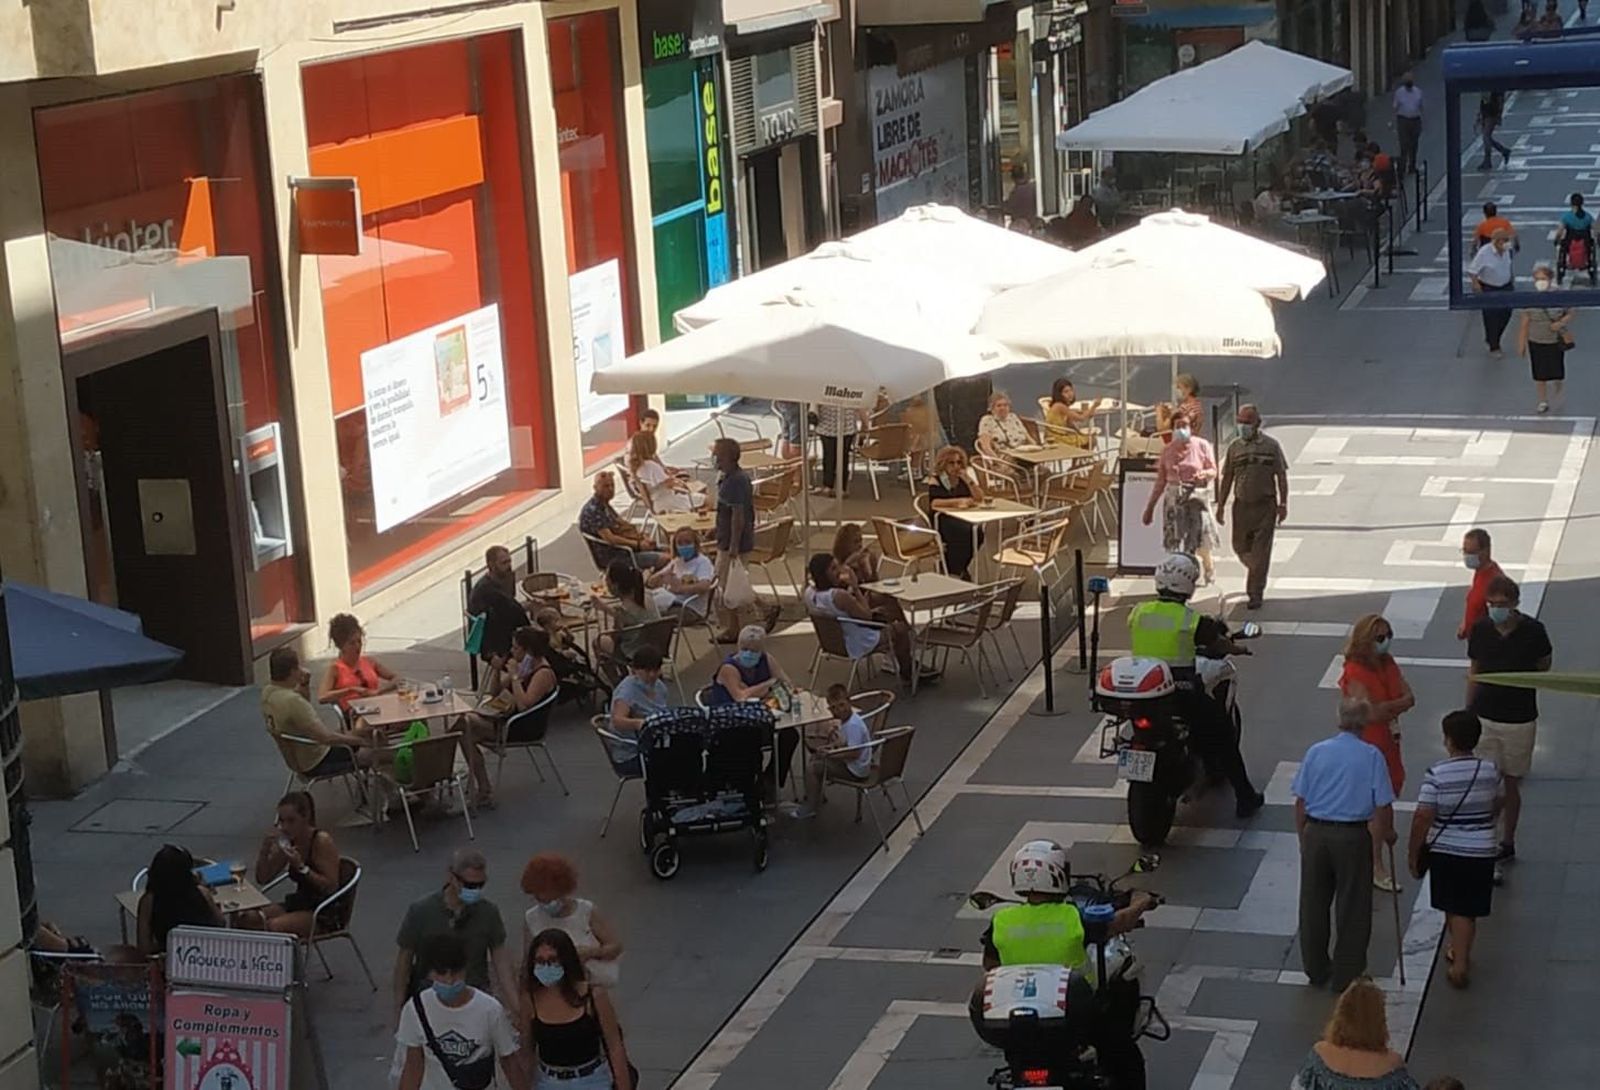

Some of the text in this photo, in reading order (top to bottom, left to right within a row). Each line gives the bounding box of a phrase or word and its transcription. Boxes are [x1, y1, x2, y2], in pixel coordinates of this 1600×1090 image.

[875, 77, 925, 116] ZAMORA
[876, 111, 921, 151] LIBRE DE
[1222, 338, 1263, 348] Mahou
[477, 363, 488, 401] 5
[824, 385, 864, 399] Mahou
[176, 945, 236, 969] VAQUERO
[240, 959, 248, 970] &
[204, 1004, 251, 1021] Ropa y
[173, 1018, 280, 1038] Complementos
